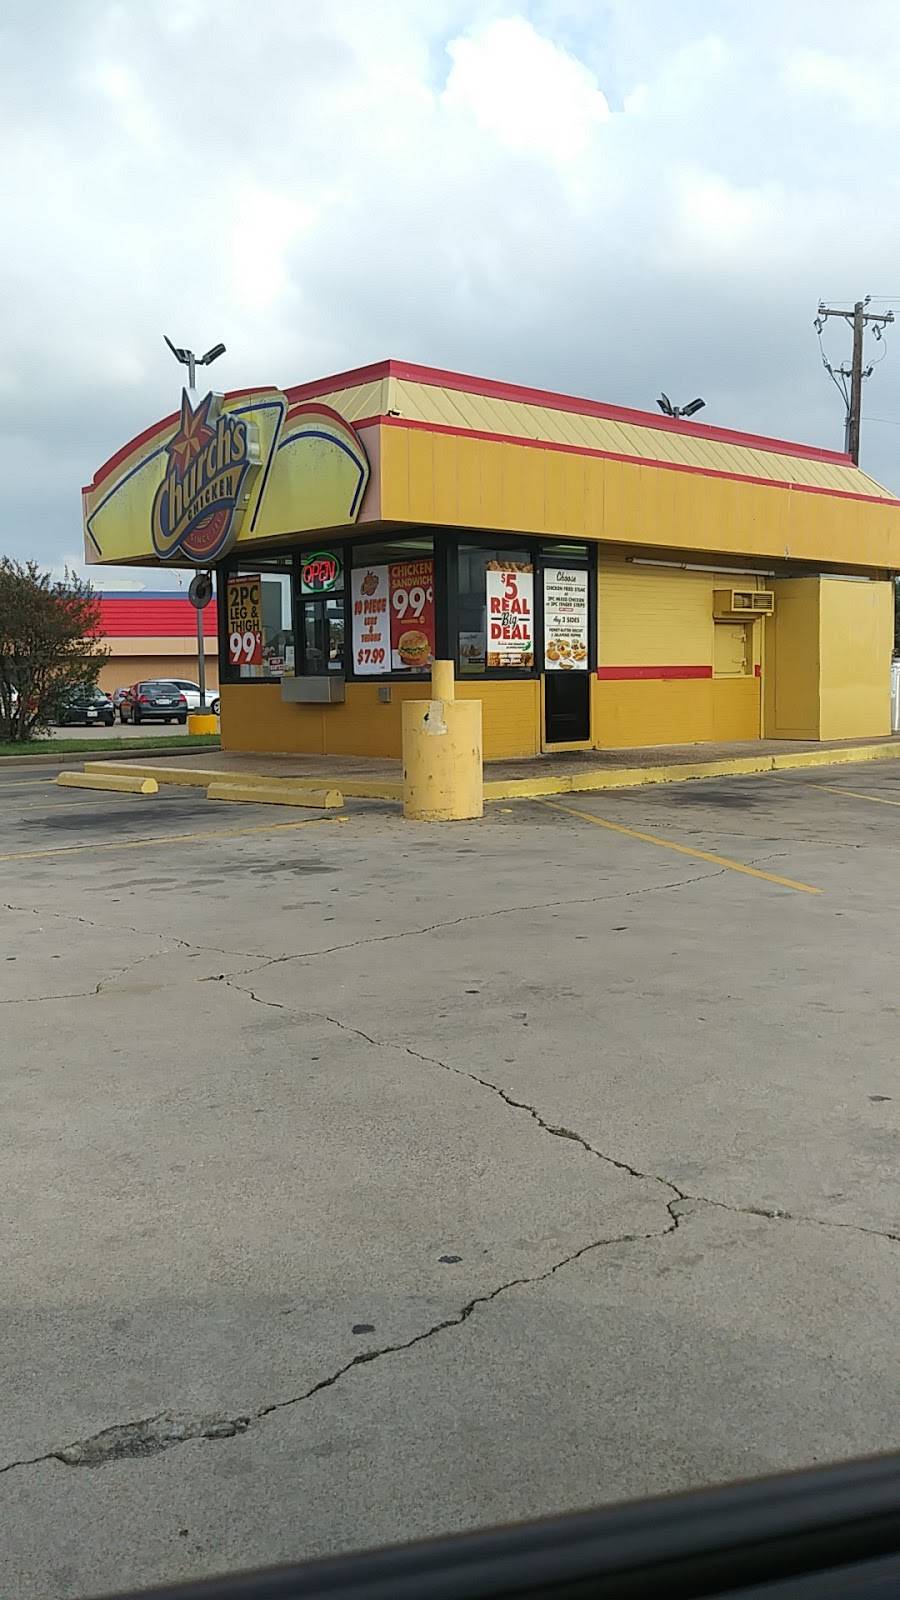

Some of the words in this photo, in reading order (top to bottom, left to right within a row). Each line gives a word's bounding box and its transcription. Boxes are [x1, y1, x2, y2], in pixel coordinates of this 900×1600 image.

[152, 418, 247, 551] Church's
[187, 475, 233, 521] CHICKEN
[303, 560, 336, 583] OPEN
[391, 562, 432, 577] CHICKEN
[556, 571, 576, 582] Choose
[391, 575, 432, 588] SANDWICH
[501, 573, 517, 599] $5
[229, 585, 259, 606] 2PC
[230, 607, 248, 620] LEG
[250, 606, 259, 618] &
[364, 598, 386, 613] PIECE
[490, 597, 530, 614] REAL
[230, 619, 260, 633] THIGH
[501, 612, 517, 629] Big
[490, 623, 530, 639] DEAL
[357, 648, 384, 664] $7.99
